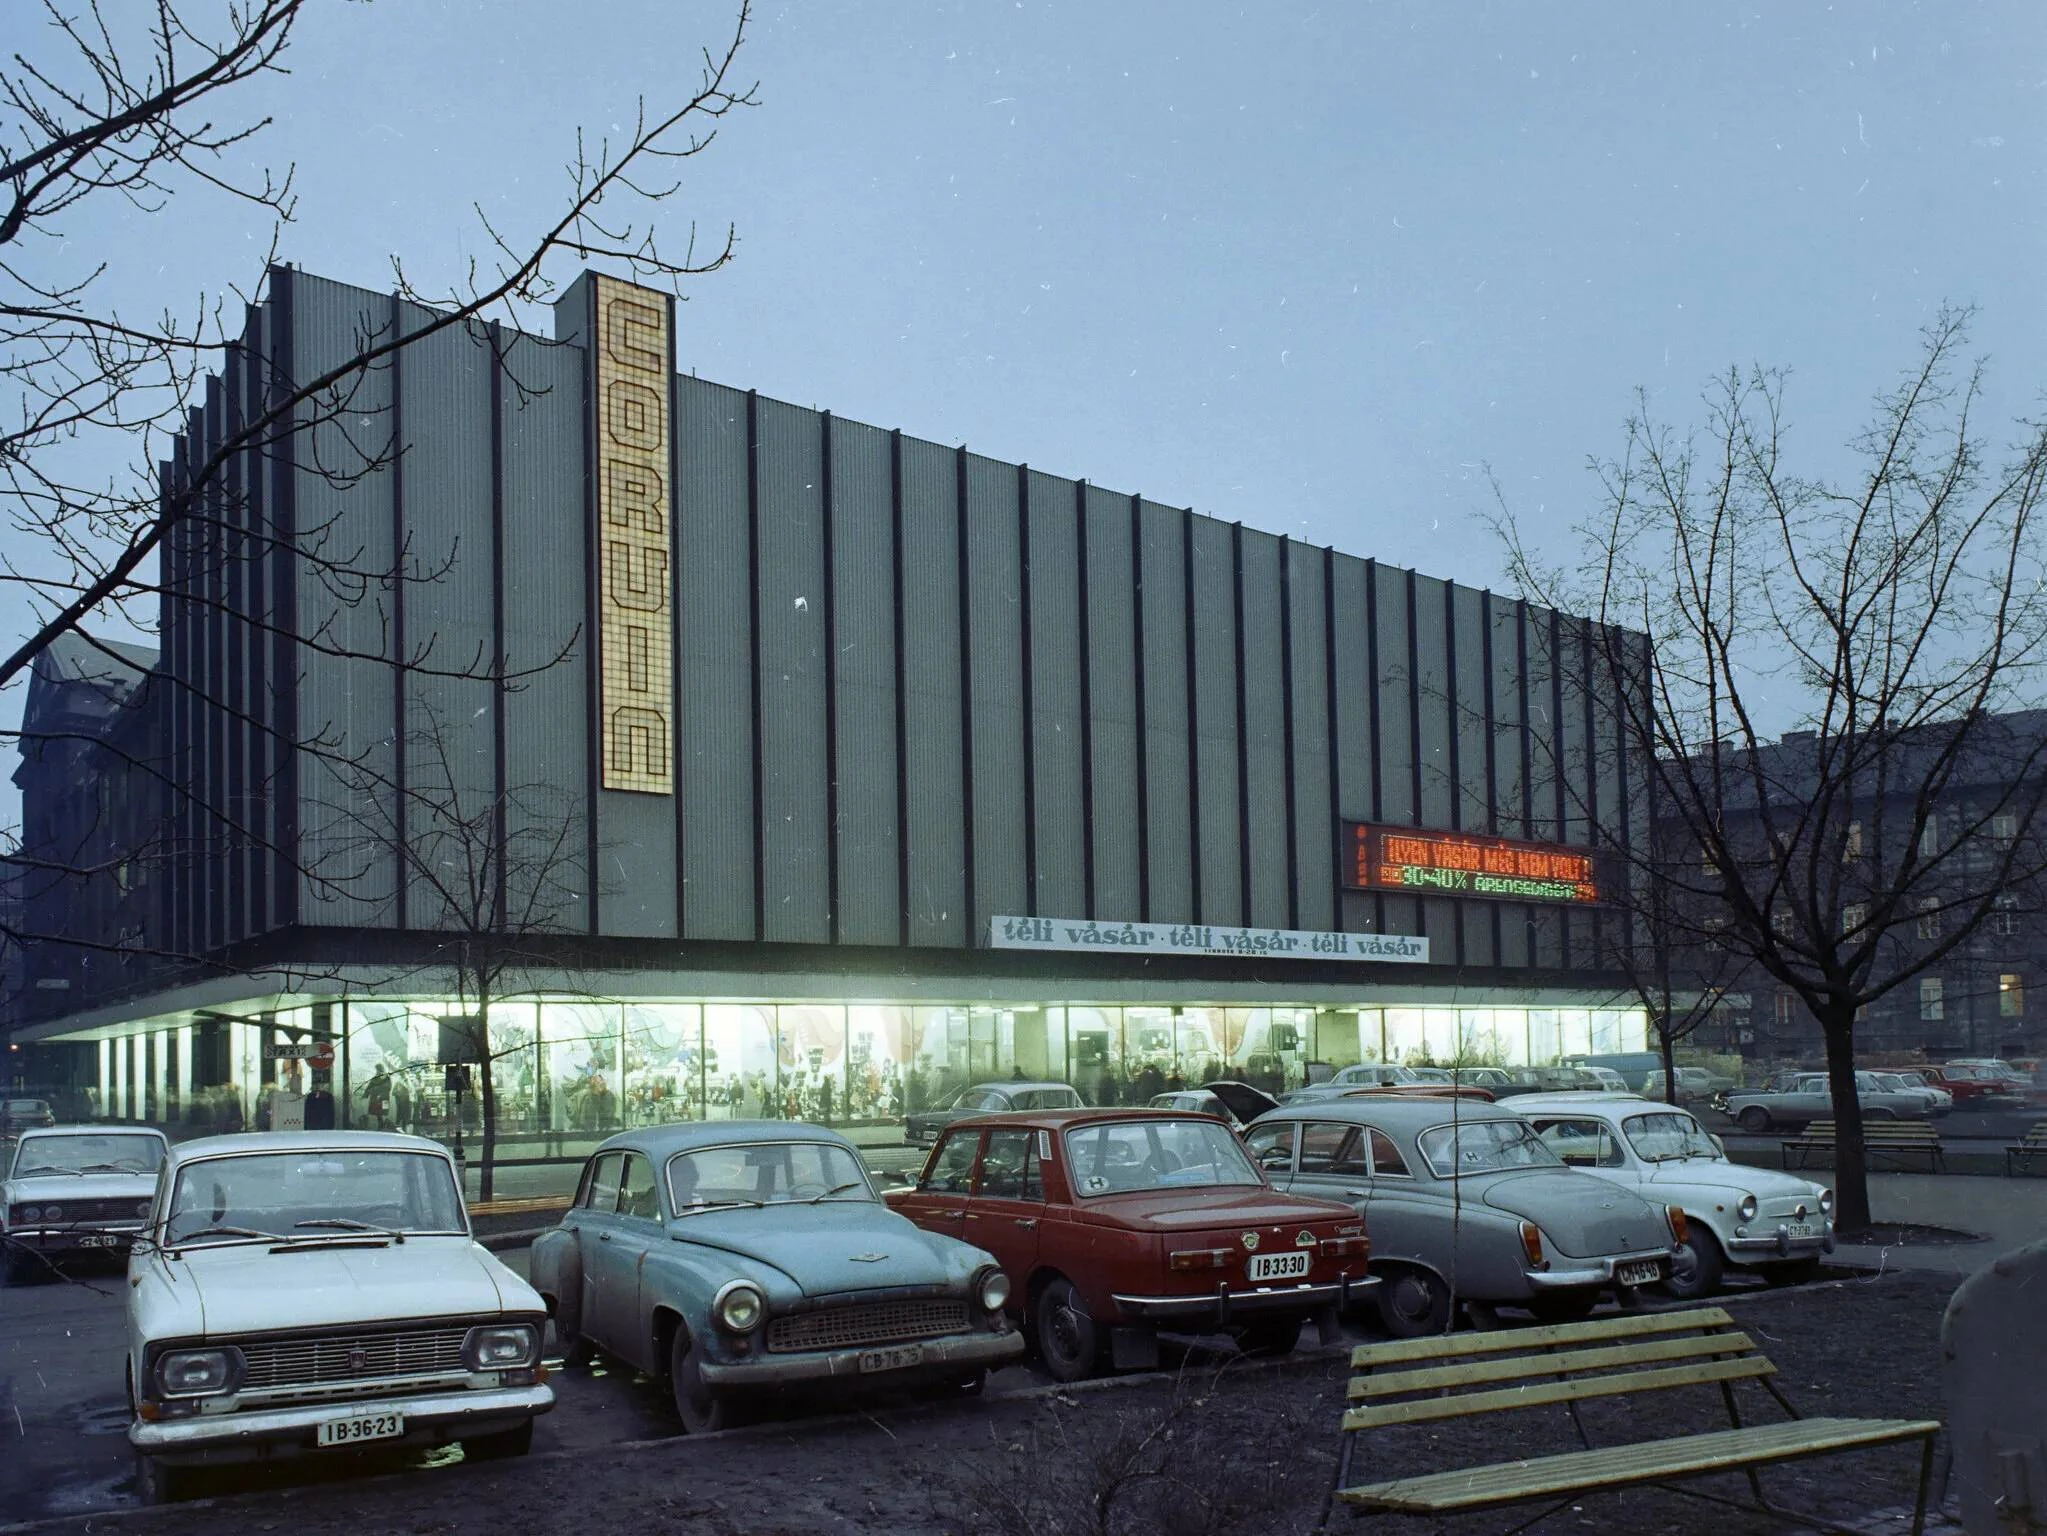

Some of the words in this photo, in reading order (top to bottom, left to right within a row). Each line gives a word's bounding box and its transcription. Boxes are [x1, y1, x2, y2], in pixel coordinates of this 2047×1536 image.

[1003, 918, 1054, 942] téli
[1065, 921, 1155, 946] vásár
[1169, 925, 1213, 948] téli
[1221, 929, 1299, 951] vásár
[1310, 933, 1349, 954] téli
[1356, 935, 1422, 957] vásár
[1088, 1178, 1104, 1188] H
